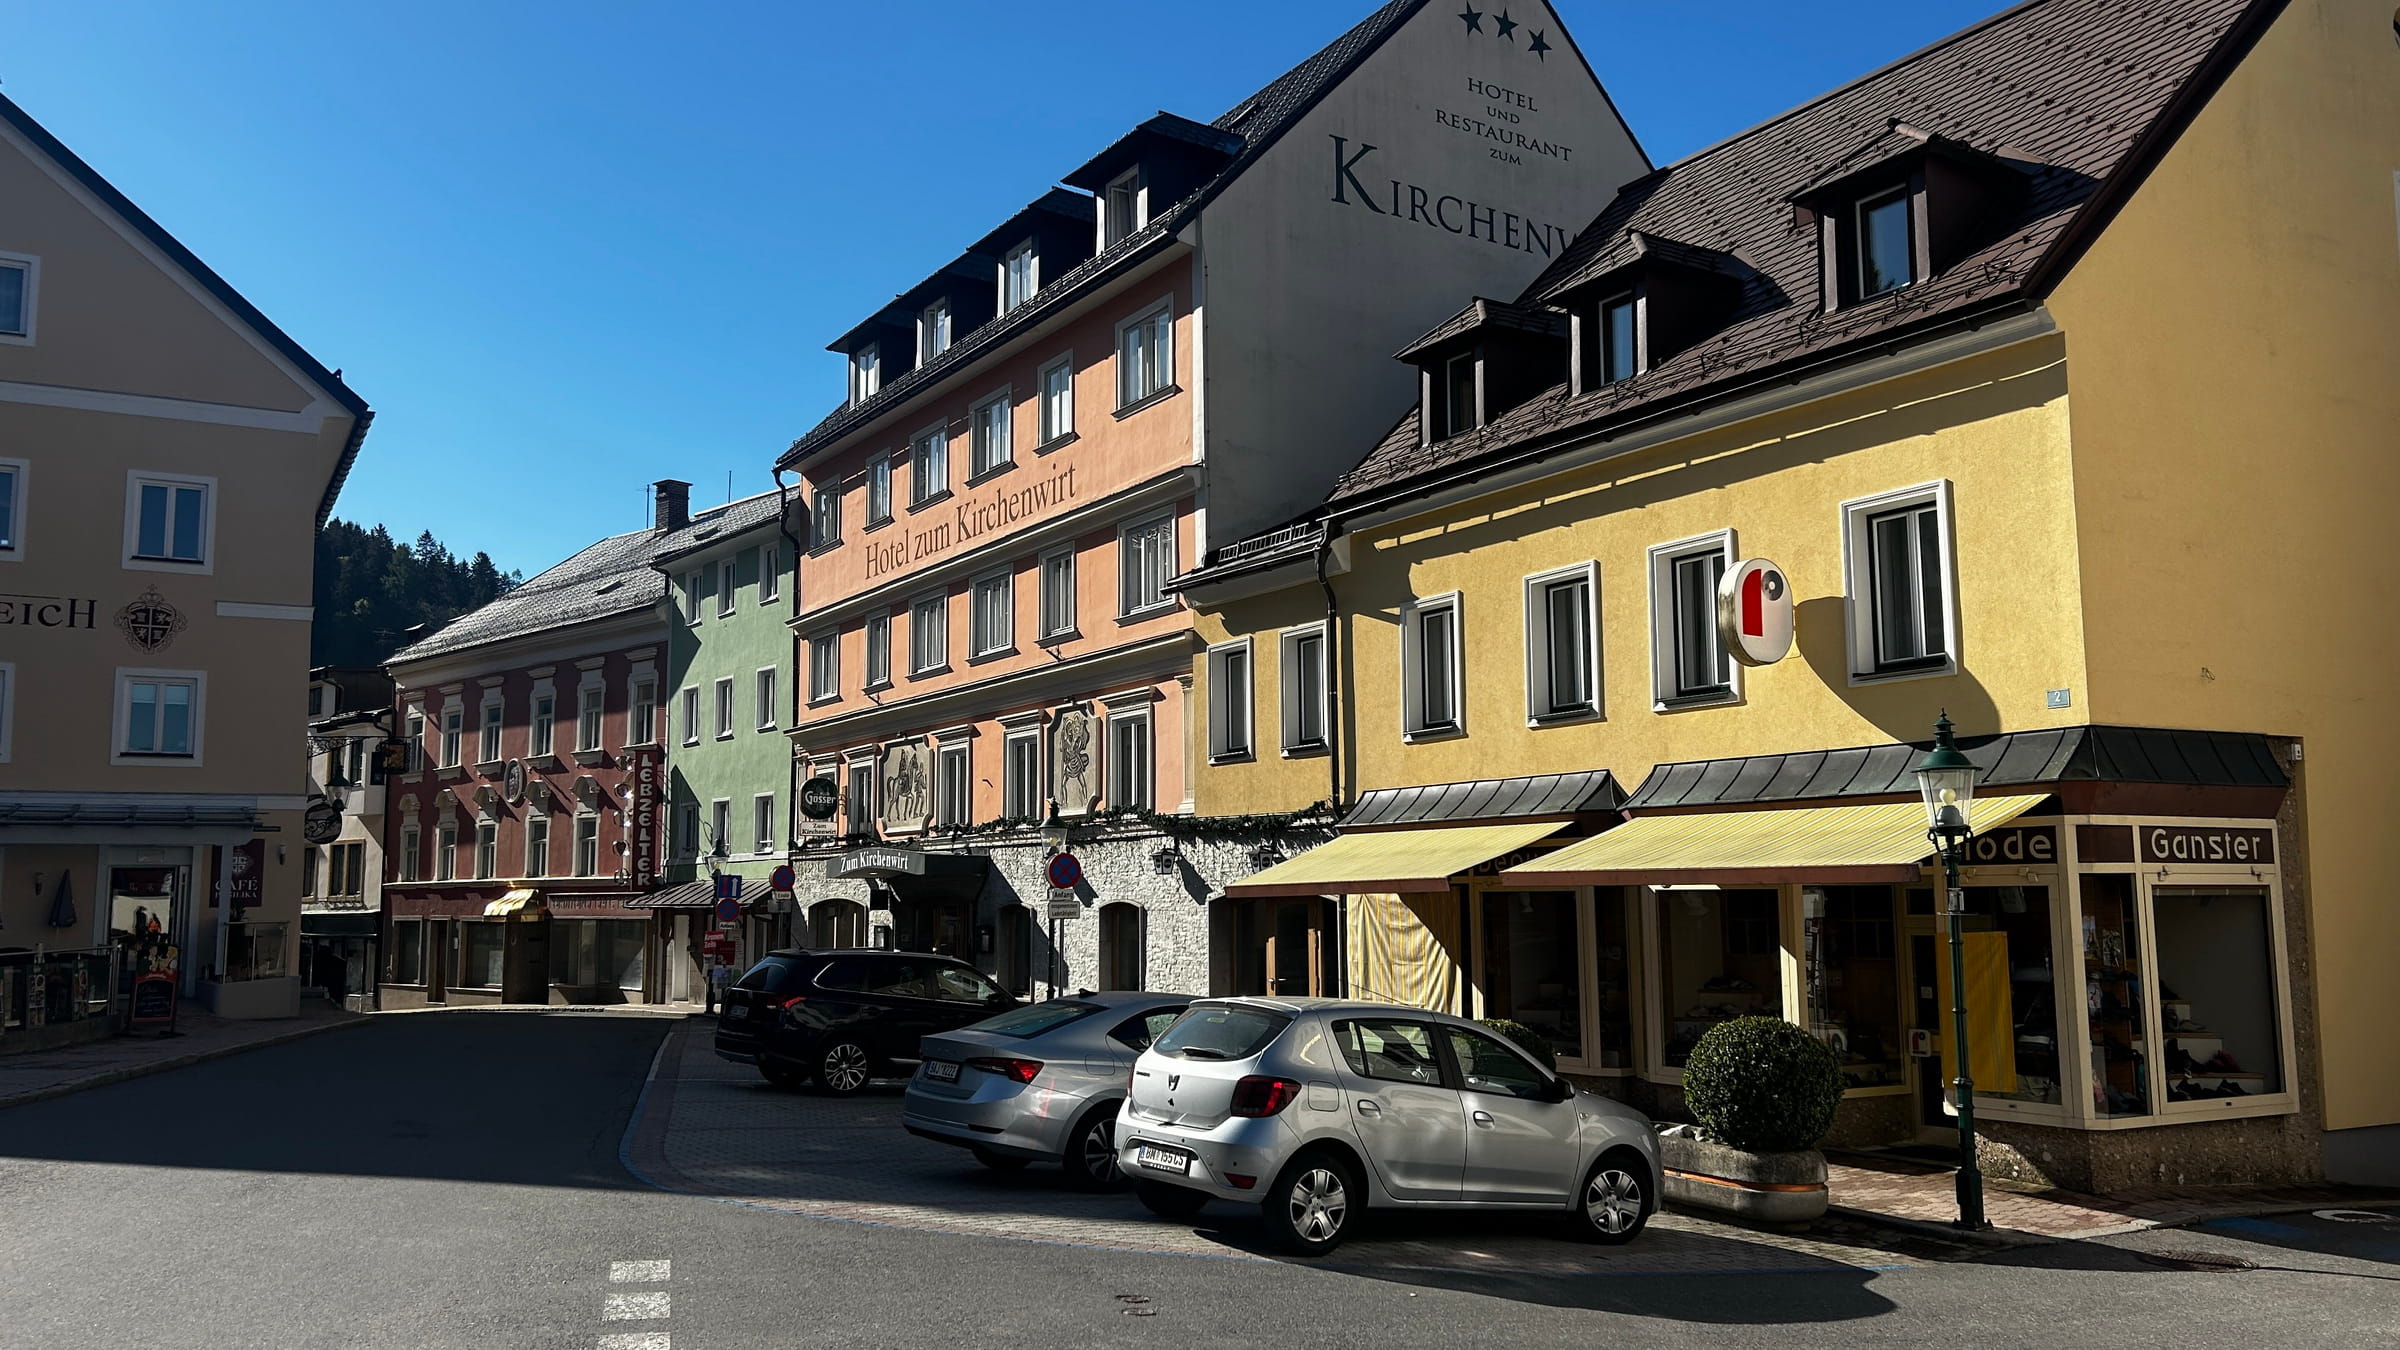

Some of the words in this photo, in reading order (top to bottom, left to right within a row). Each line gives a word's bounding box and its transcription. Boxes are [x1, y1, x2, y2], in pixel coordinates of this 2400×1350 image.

[1467, 77, 1538, 113] HOTEL
[1486, 106, 1520, 124] UND
[1434, 109, 1572, 162] RESTAURANT
[1489, 147, 1522, 166] ZUM
[865, 530, 910, 580] Hotel
[914, 522, 951, 561] zum
[956, 462, 1076, 543] Kirchenwirt
[2054, 691, 2061, 702] 2
[637, 753, 653, 886] LEBZELTER
[840, 852, 858, 872] Zum
[859, 848, 908, 871] Kirchenwirt
[2151, 829, 2263, 861] Ganster
